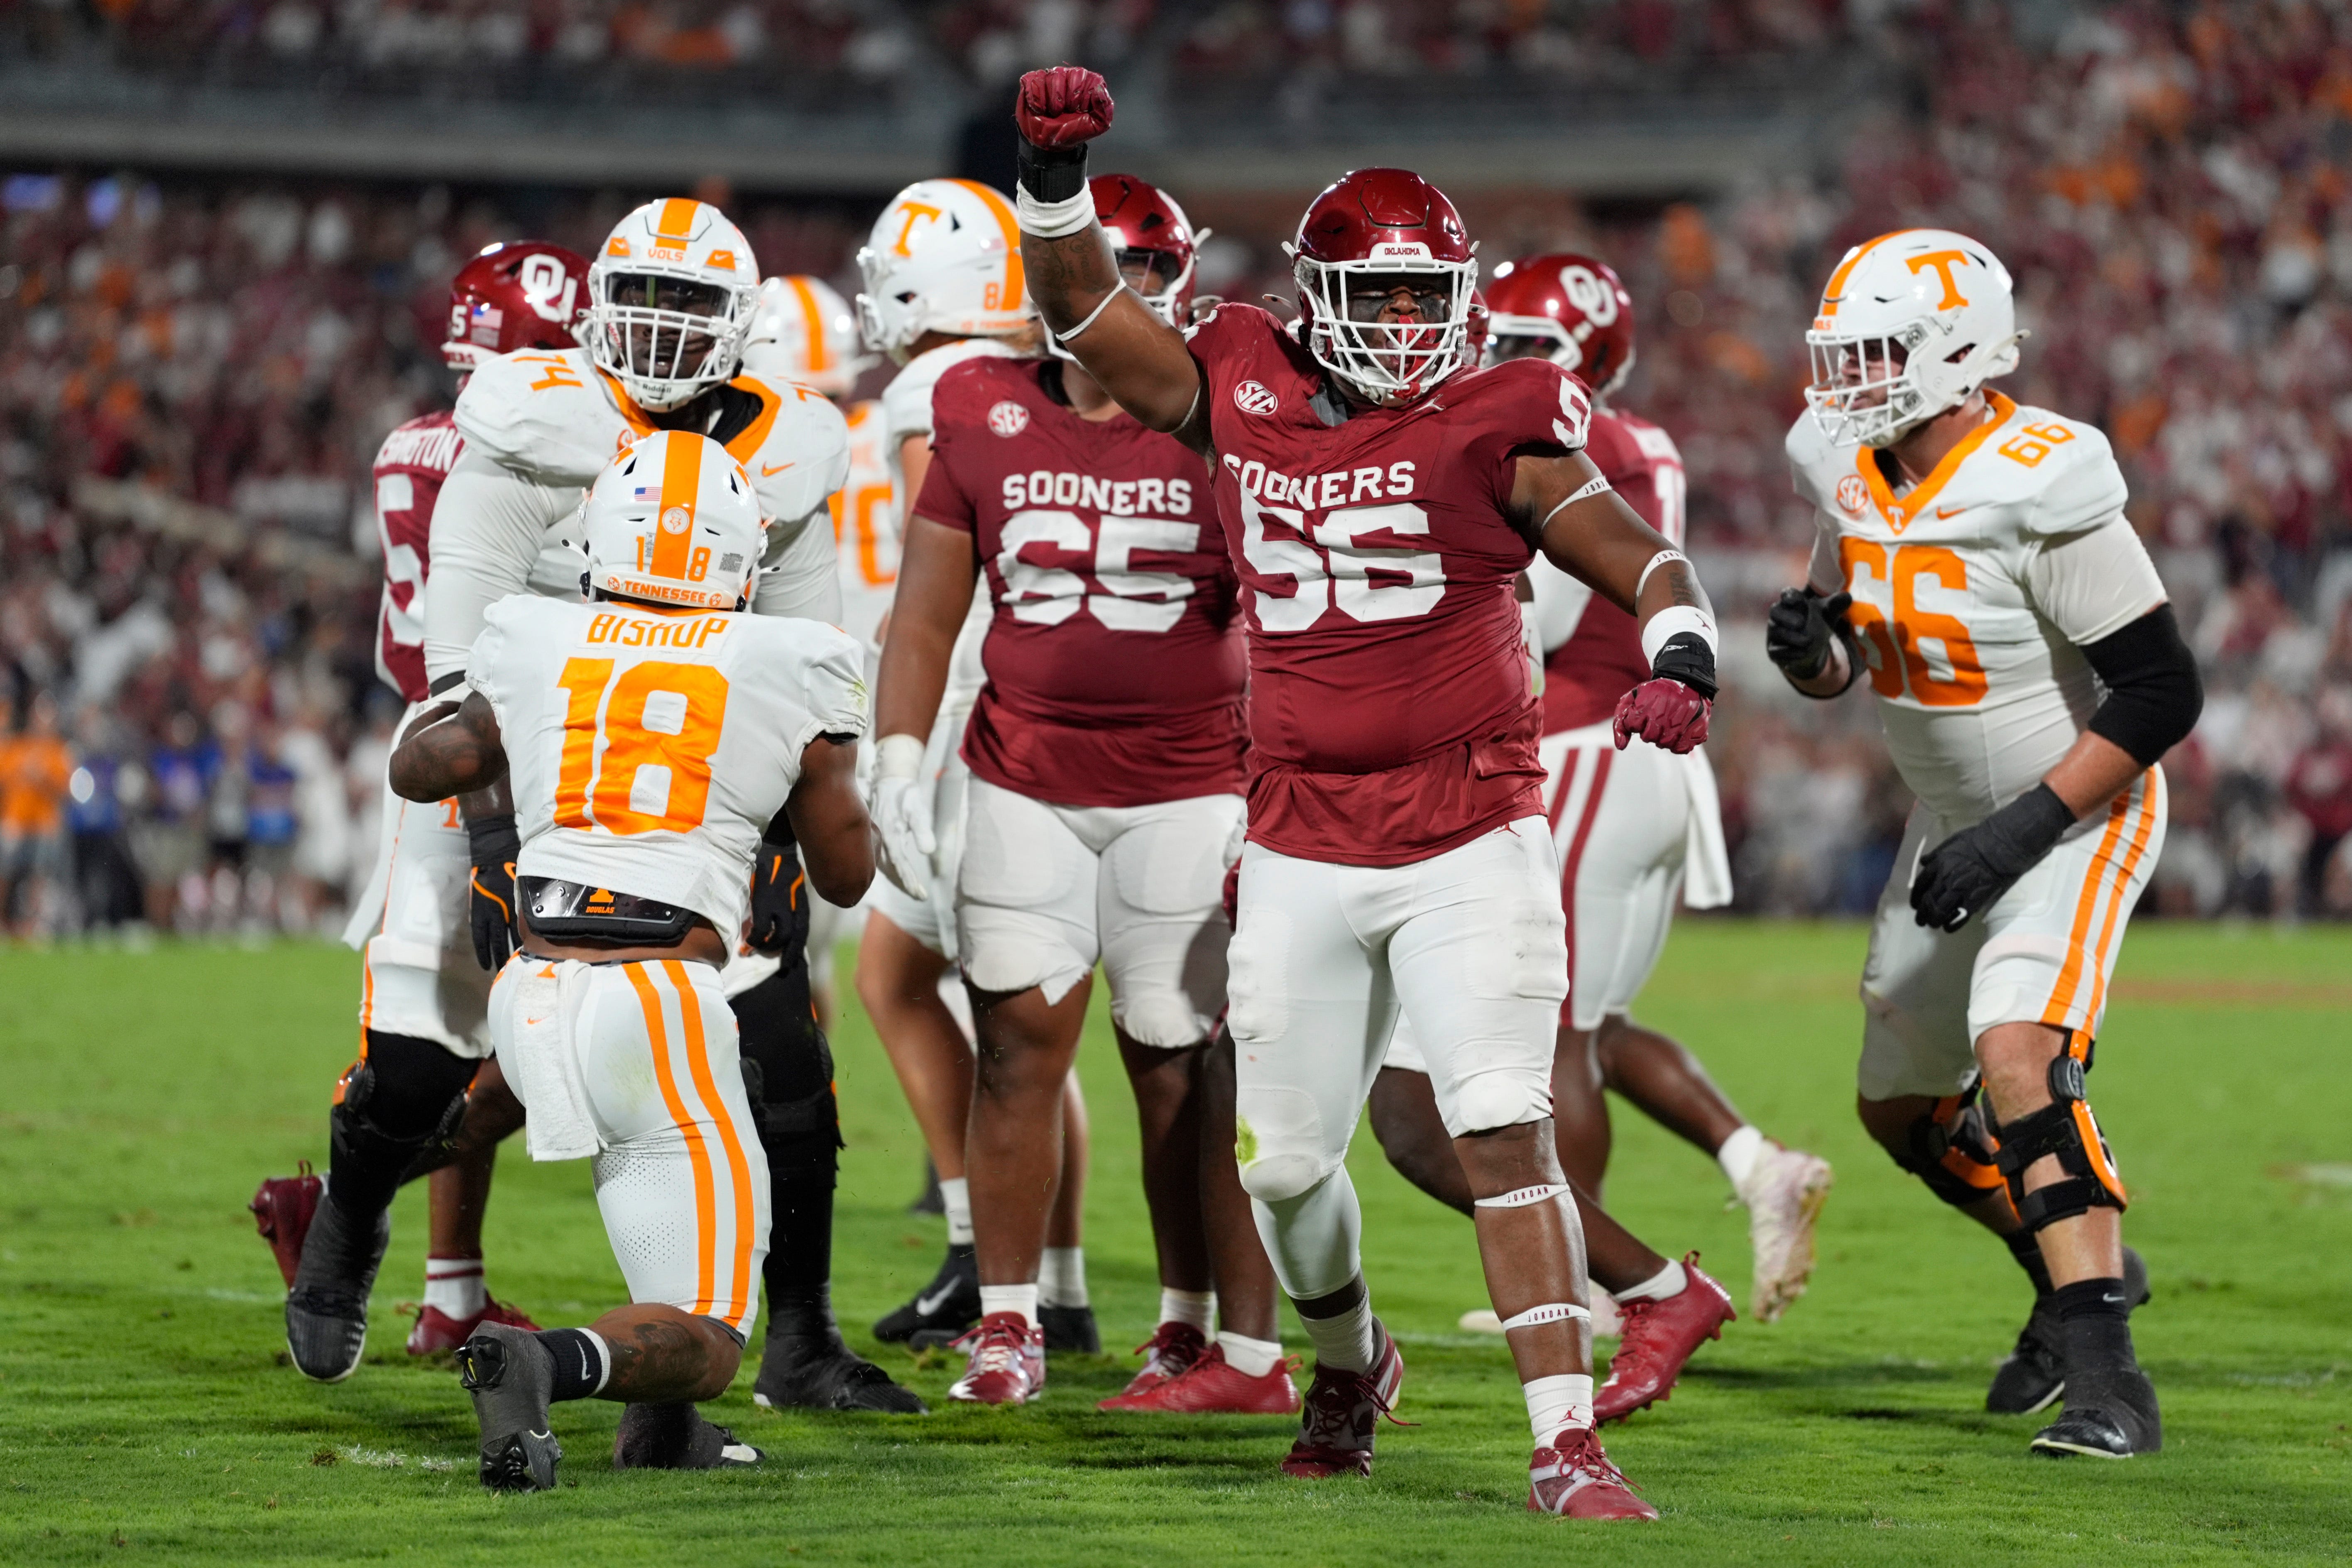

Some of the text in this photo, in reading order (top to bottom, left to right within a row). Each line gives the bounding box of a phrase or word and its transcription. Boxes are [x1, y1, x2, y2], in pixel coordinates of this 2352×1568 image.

[891, 201, 942, 257] T
[647, 249, 684, 262] VOLS
[1384, 247, 1421, 256] OKLAHOMA
[1904, 250, 1970, 311] T
[451, 304, 467, 338] 5
[1236, 382, 1276, 414] SEC
[990, 403, 1028, 436] SEC
[1002, 470, 1192, 516] SOONERS
[1838, 476, 1867, 511] SEC
[1887, 505, 1905, 531] T
[996, 510, 1201, 633] 65
[1240, 502, 1447, 632] 56
[624, 580, 707, 603] TENNESSEE
[1839, 535, 1989, 706] 66
[553, 657, 729, 835] 18
[1507, 1186, 1549, 1203] JORDAN
[1528, 1308, 1569, 1322] JORDAN
